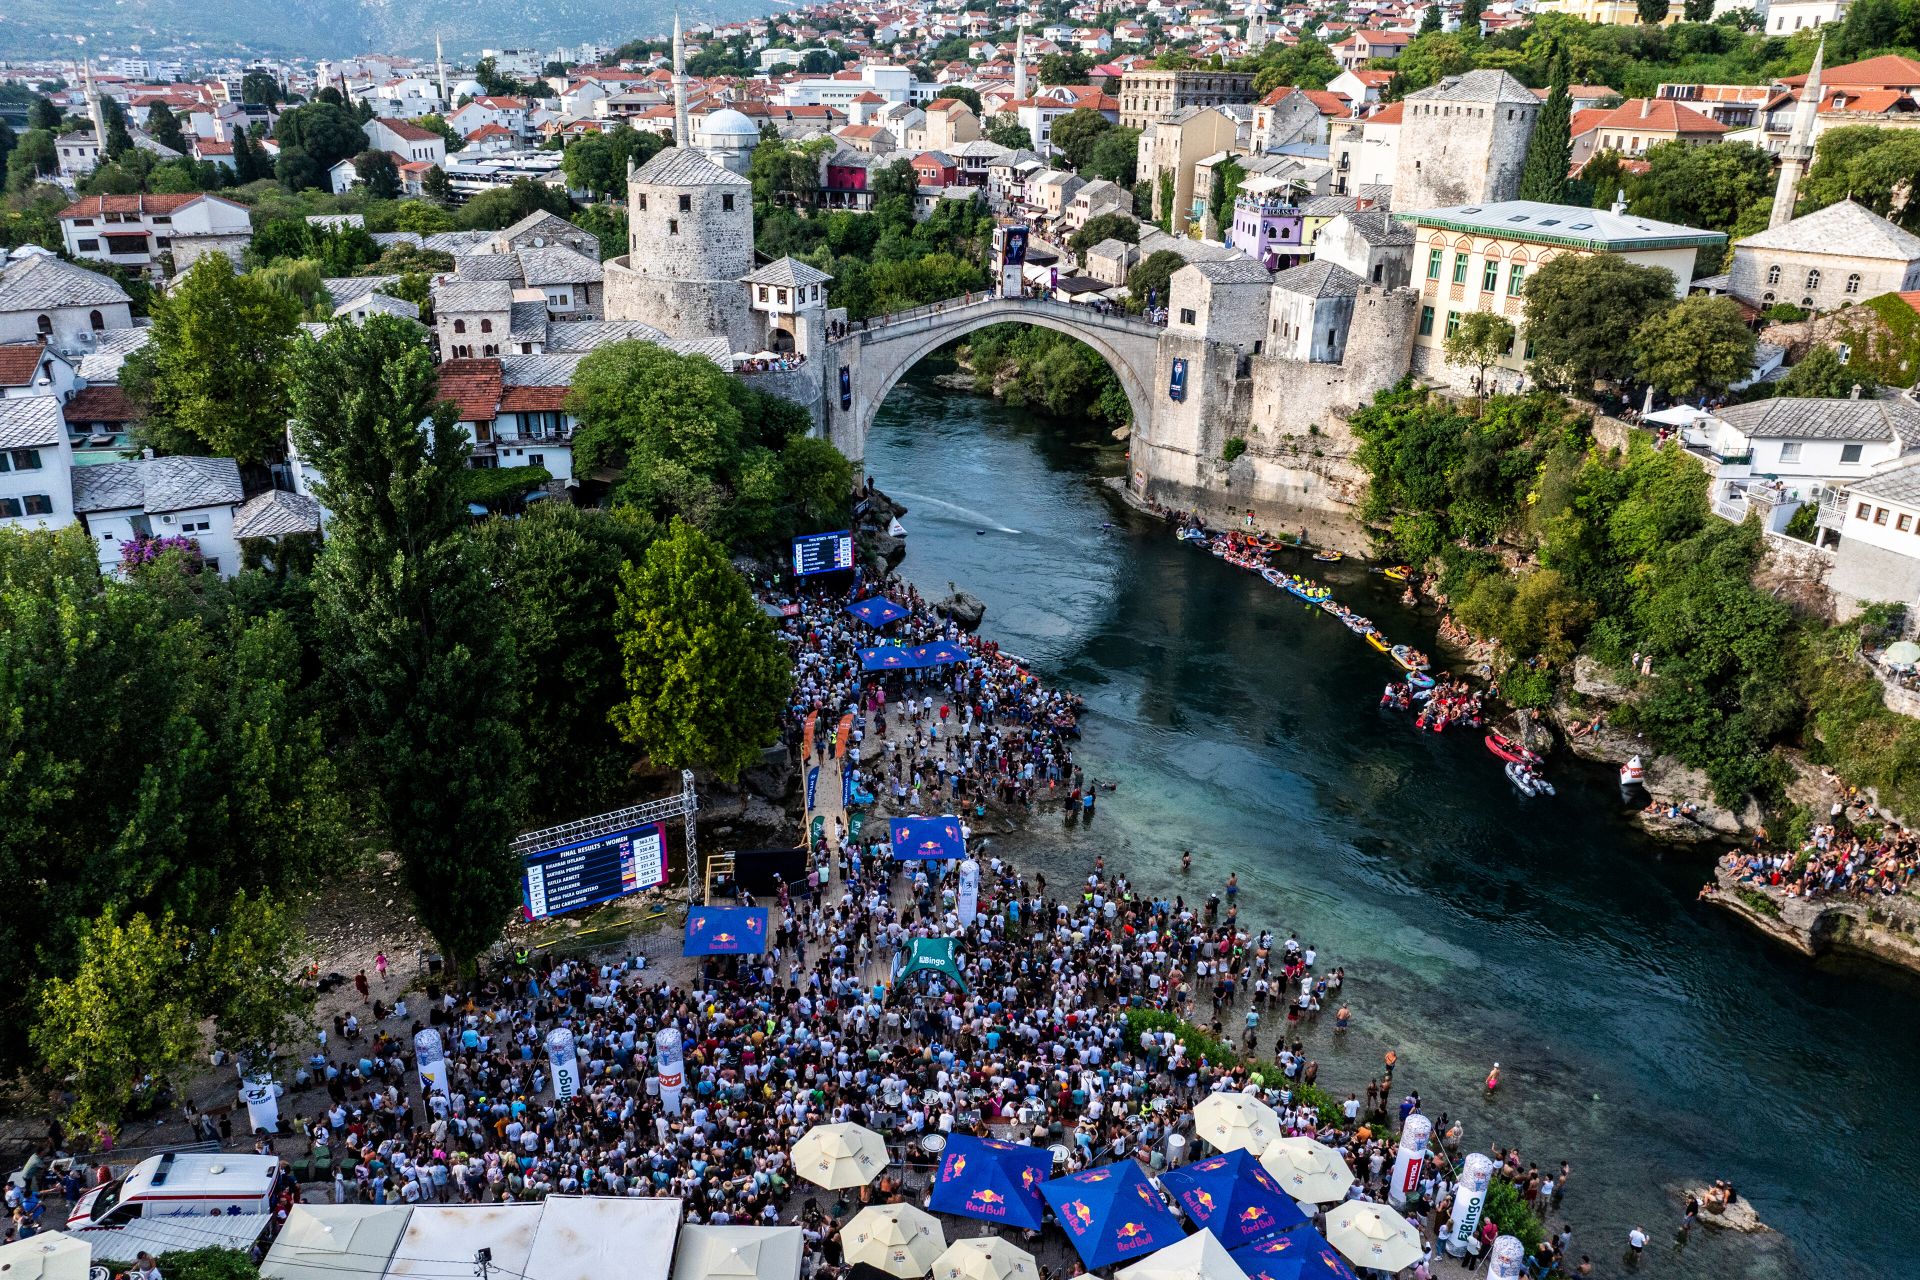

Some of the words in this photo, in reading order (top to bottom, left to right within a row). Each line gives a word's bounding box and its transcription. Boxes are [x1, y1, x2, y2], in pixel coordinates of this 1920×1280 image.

[560, 850, 576, 858] FINAL
[577, 843, 600, 853] RESULTS
[605, 836, 628, 846] WOMEN
[924, 956, 945, 966] Bingo
[558, 1069, 572, 1103] Bingo
[946, 1154, 956, 1168] Red
[942, 1166, 952, 1182] Bull
[1408, 1162, 1419, 1190] PETROL
[966, 1200, 986, 1212] Red
[986, 1205, 1006, 1216] Bull
[1182, 1192, 1196, 1206] Red
[1192, 1204, 1208, 1220] Bull
[1461, 1197, 1480, 1235] Bingo
[1062, 1202, 1075, 1222] Red
[1070, 1218, 1085, 1236] Bull
[1240, 1222, 1259, 1234] Red
[1258, 1216, 1274, 1228] Bull
[1118, 1238, 1136, 1250] Red
[1134, 1234, 1152, 1246] Bull
